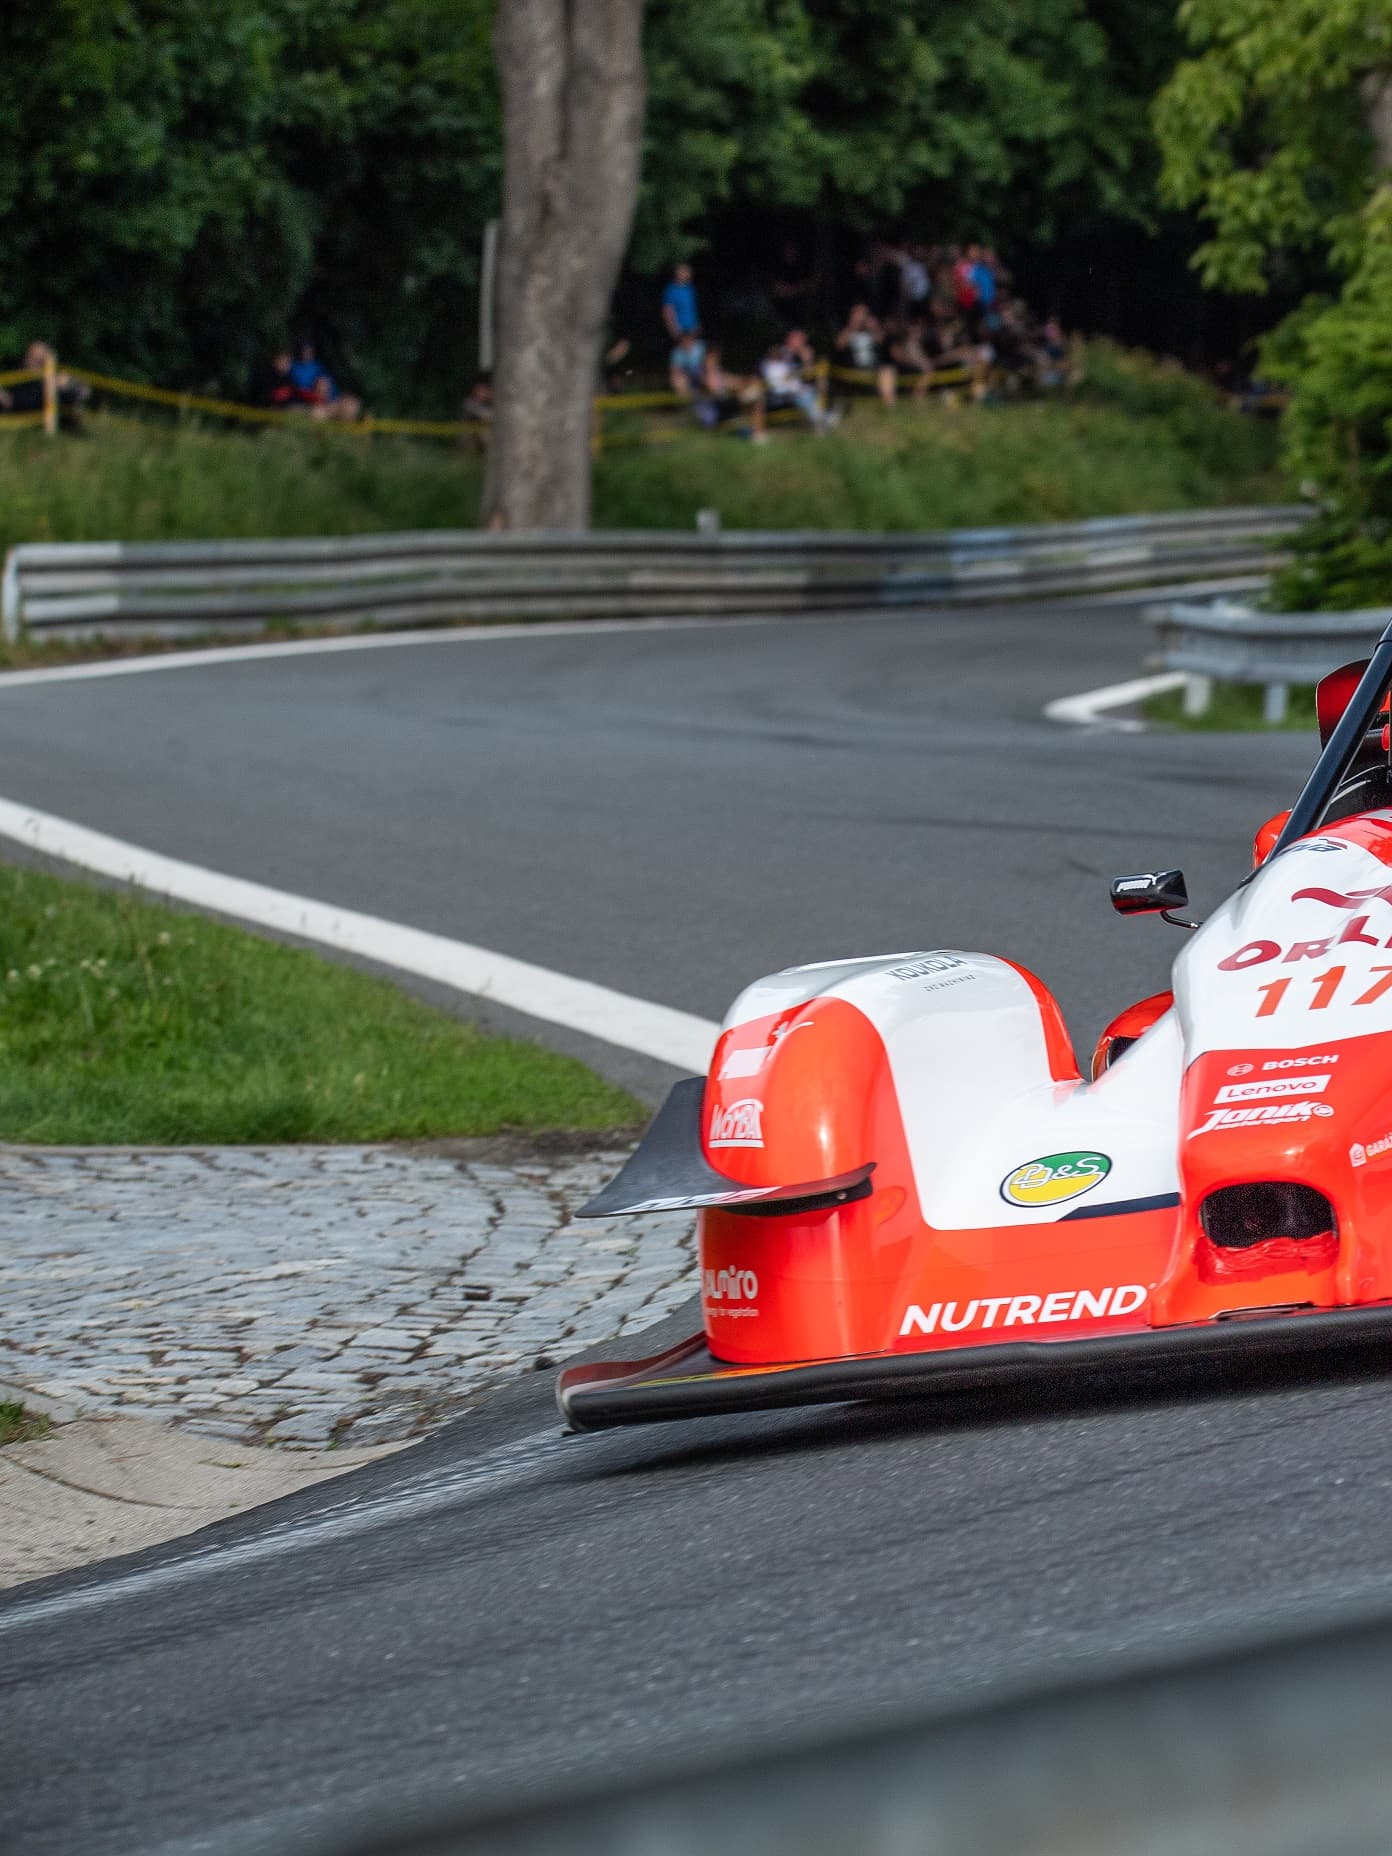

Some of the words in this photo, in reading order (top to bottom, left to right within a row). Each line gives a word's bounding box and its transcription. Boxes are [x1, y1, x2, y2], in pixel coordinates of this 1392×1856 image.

[1262, 1054, 1339, 1071] BOSCH
[1226, 1079, 1316, 1098] Lenovo
[899, 1284, 1148, 1336] NUTREND
